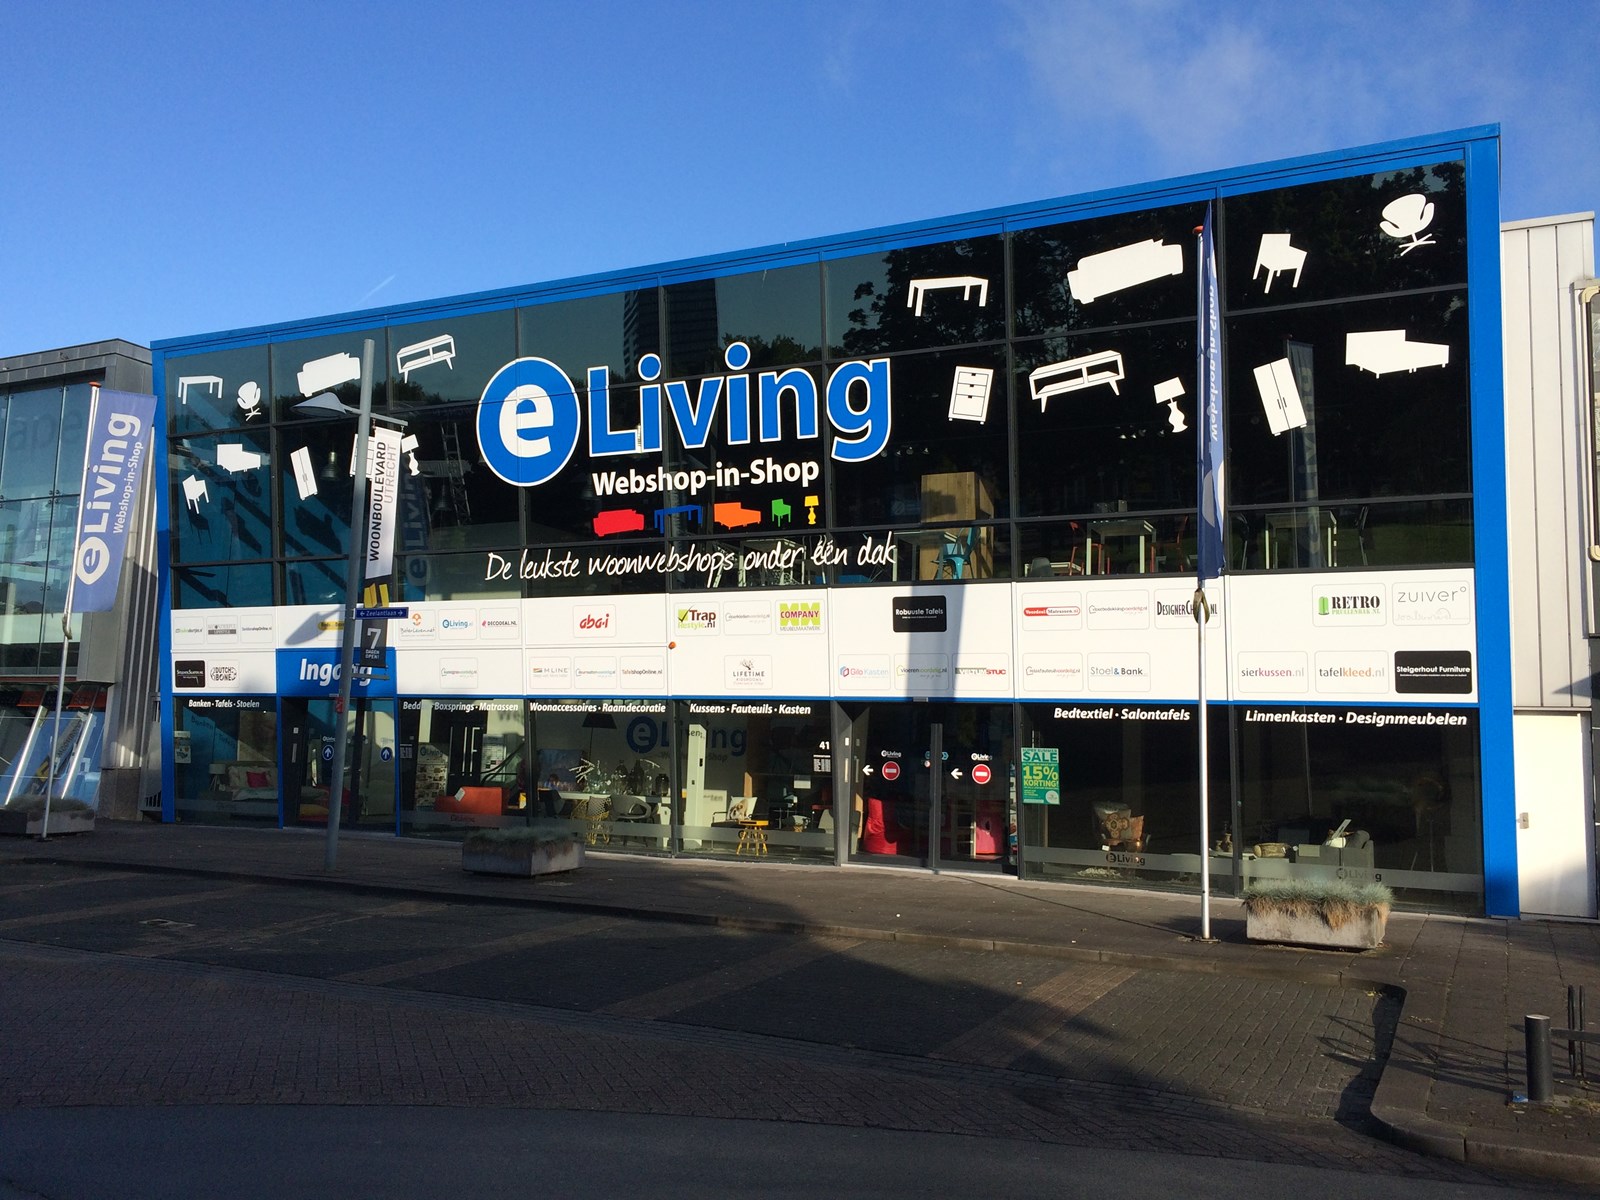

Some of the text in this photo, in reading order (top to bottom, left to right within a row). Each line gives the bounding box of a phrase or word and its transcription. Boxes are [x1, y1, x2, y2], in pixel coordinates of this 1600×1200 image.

[476, 341, 892, 487] eLiving
[383, 443, 397, 504] UTRECHT
[592, 457, 820, 497] Webshop-in-Shop
[113, 441, 144, 534] Webshop-in-Shop
[76, 412, 142, 586] eLiving
[369, 441, 387, 562] WOONBOULEVARD
[484, 531, 898, 588] De leukste woonwebshops onder één dak
[1331, 596, 1380, 609] RETRO
[690, 609, 717, 622] Trap
[780, 611, 820, 619] COMPANY
[895, 607, 944, 616] Robuuste Tafels
[367, 627, 382, 650] 7
[300, 658, 373, 687] Ingag
[1241, 666, 1305, 678] sierkussen.nl
[1318, 666, 1385, 678] tafelkleed.nl
[1396, 665, 1471, 675] Steigerhout Furniture
[188, 699, 260, 709] Banken Tafels Stoelen
[434, 702, 475, 713] Boxsprings
[478, 702, 519, 712] Matrassen
[529, 702, 667, 713] Woonaccessoires Raamdecoratie
[689, 703, 812, 715] Kussens Fauteuils Kasten
[1053, 707, 1191, 721] Bedtextiel Salontafels
[1244, 710, 1468, 728] Linnenkasten Designmeubelen
[819, 741, 830, 750] 41
[1022, 751, 1058, 762] SALE
[1023, 765, 1059, 781] 15%
[1023, 780, 1060, 788] KORTING!
